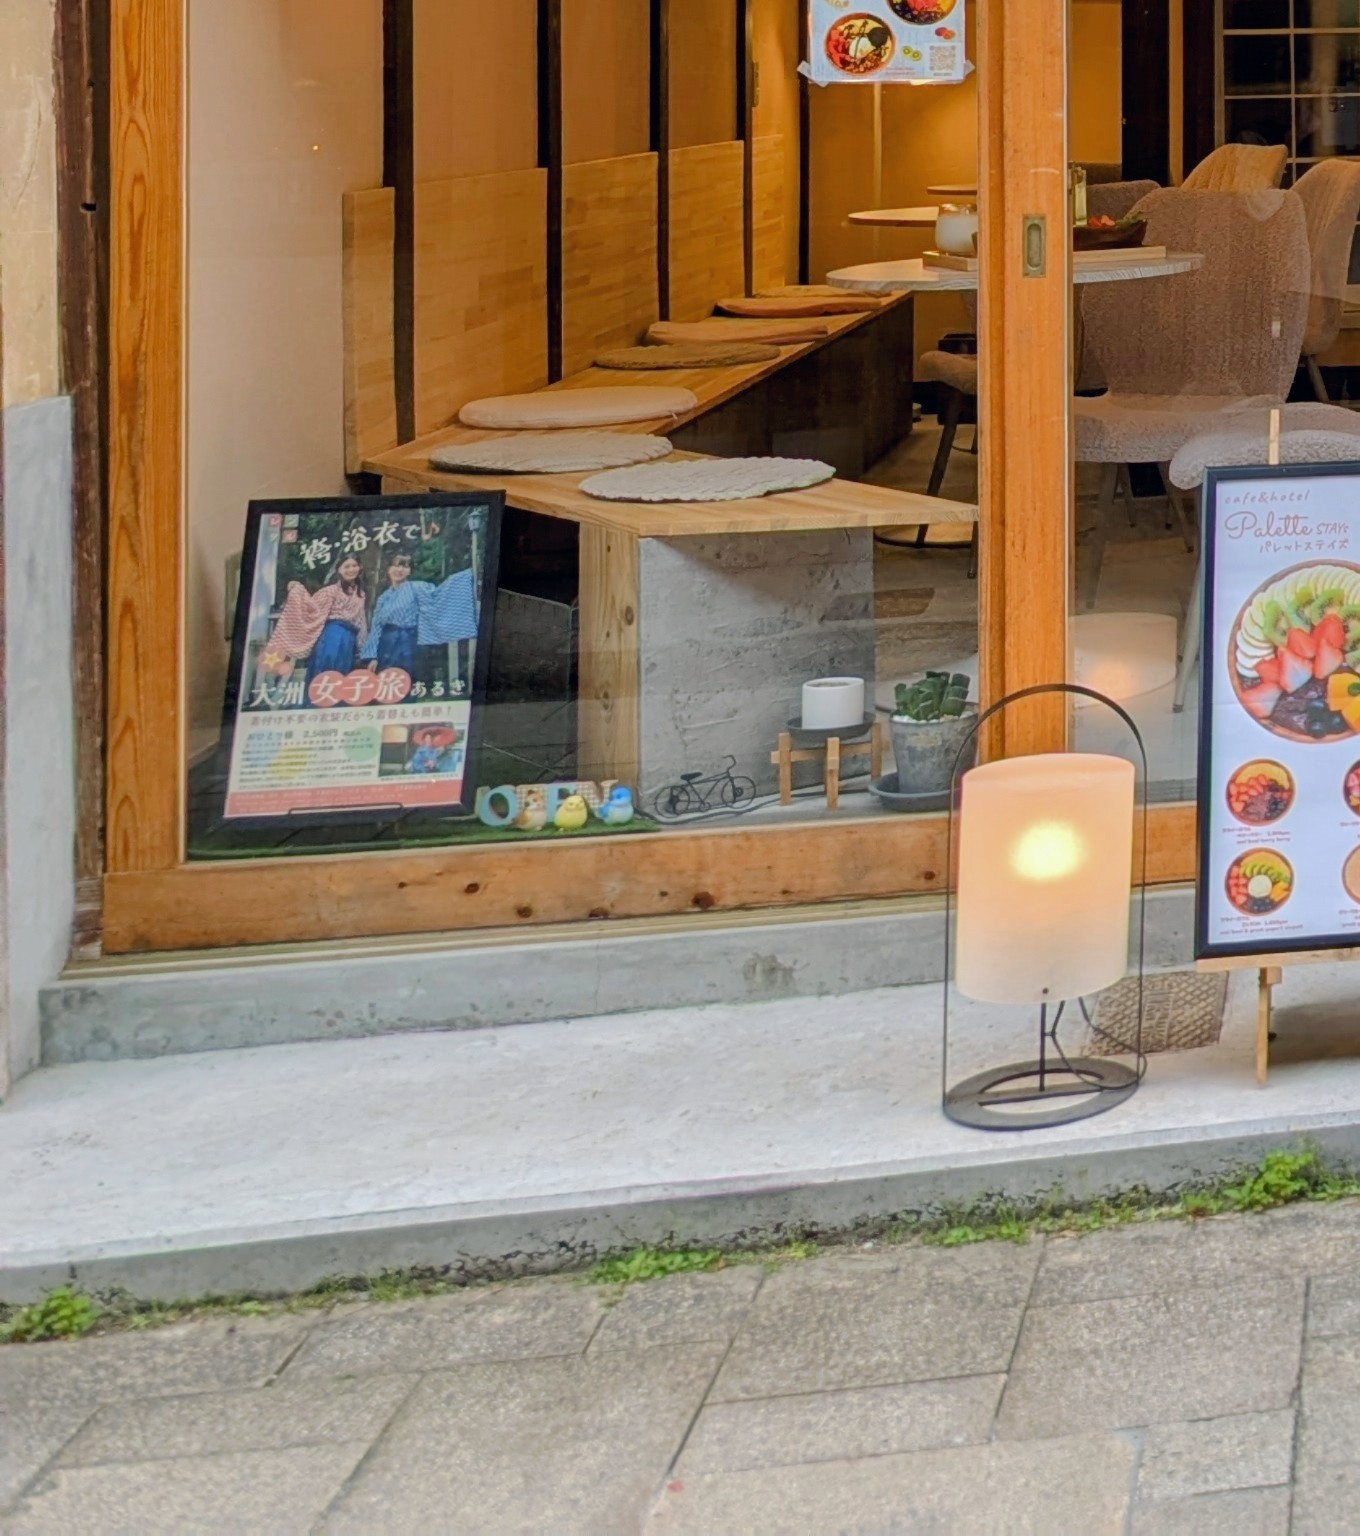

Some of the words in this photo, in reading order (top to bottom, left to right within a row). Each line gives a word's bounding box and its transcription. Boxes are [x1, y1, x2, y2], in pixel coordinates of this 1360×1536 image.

[1224, 511, 1313, 540] Palette
[1260, 538, 1349, 553] パレットステイズ
